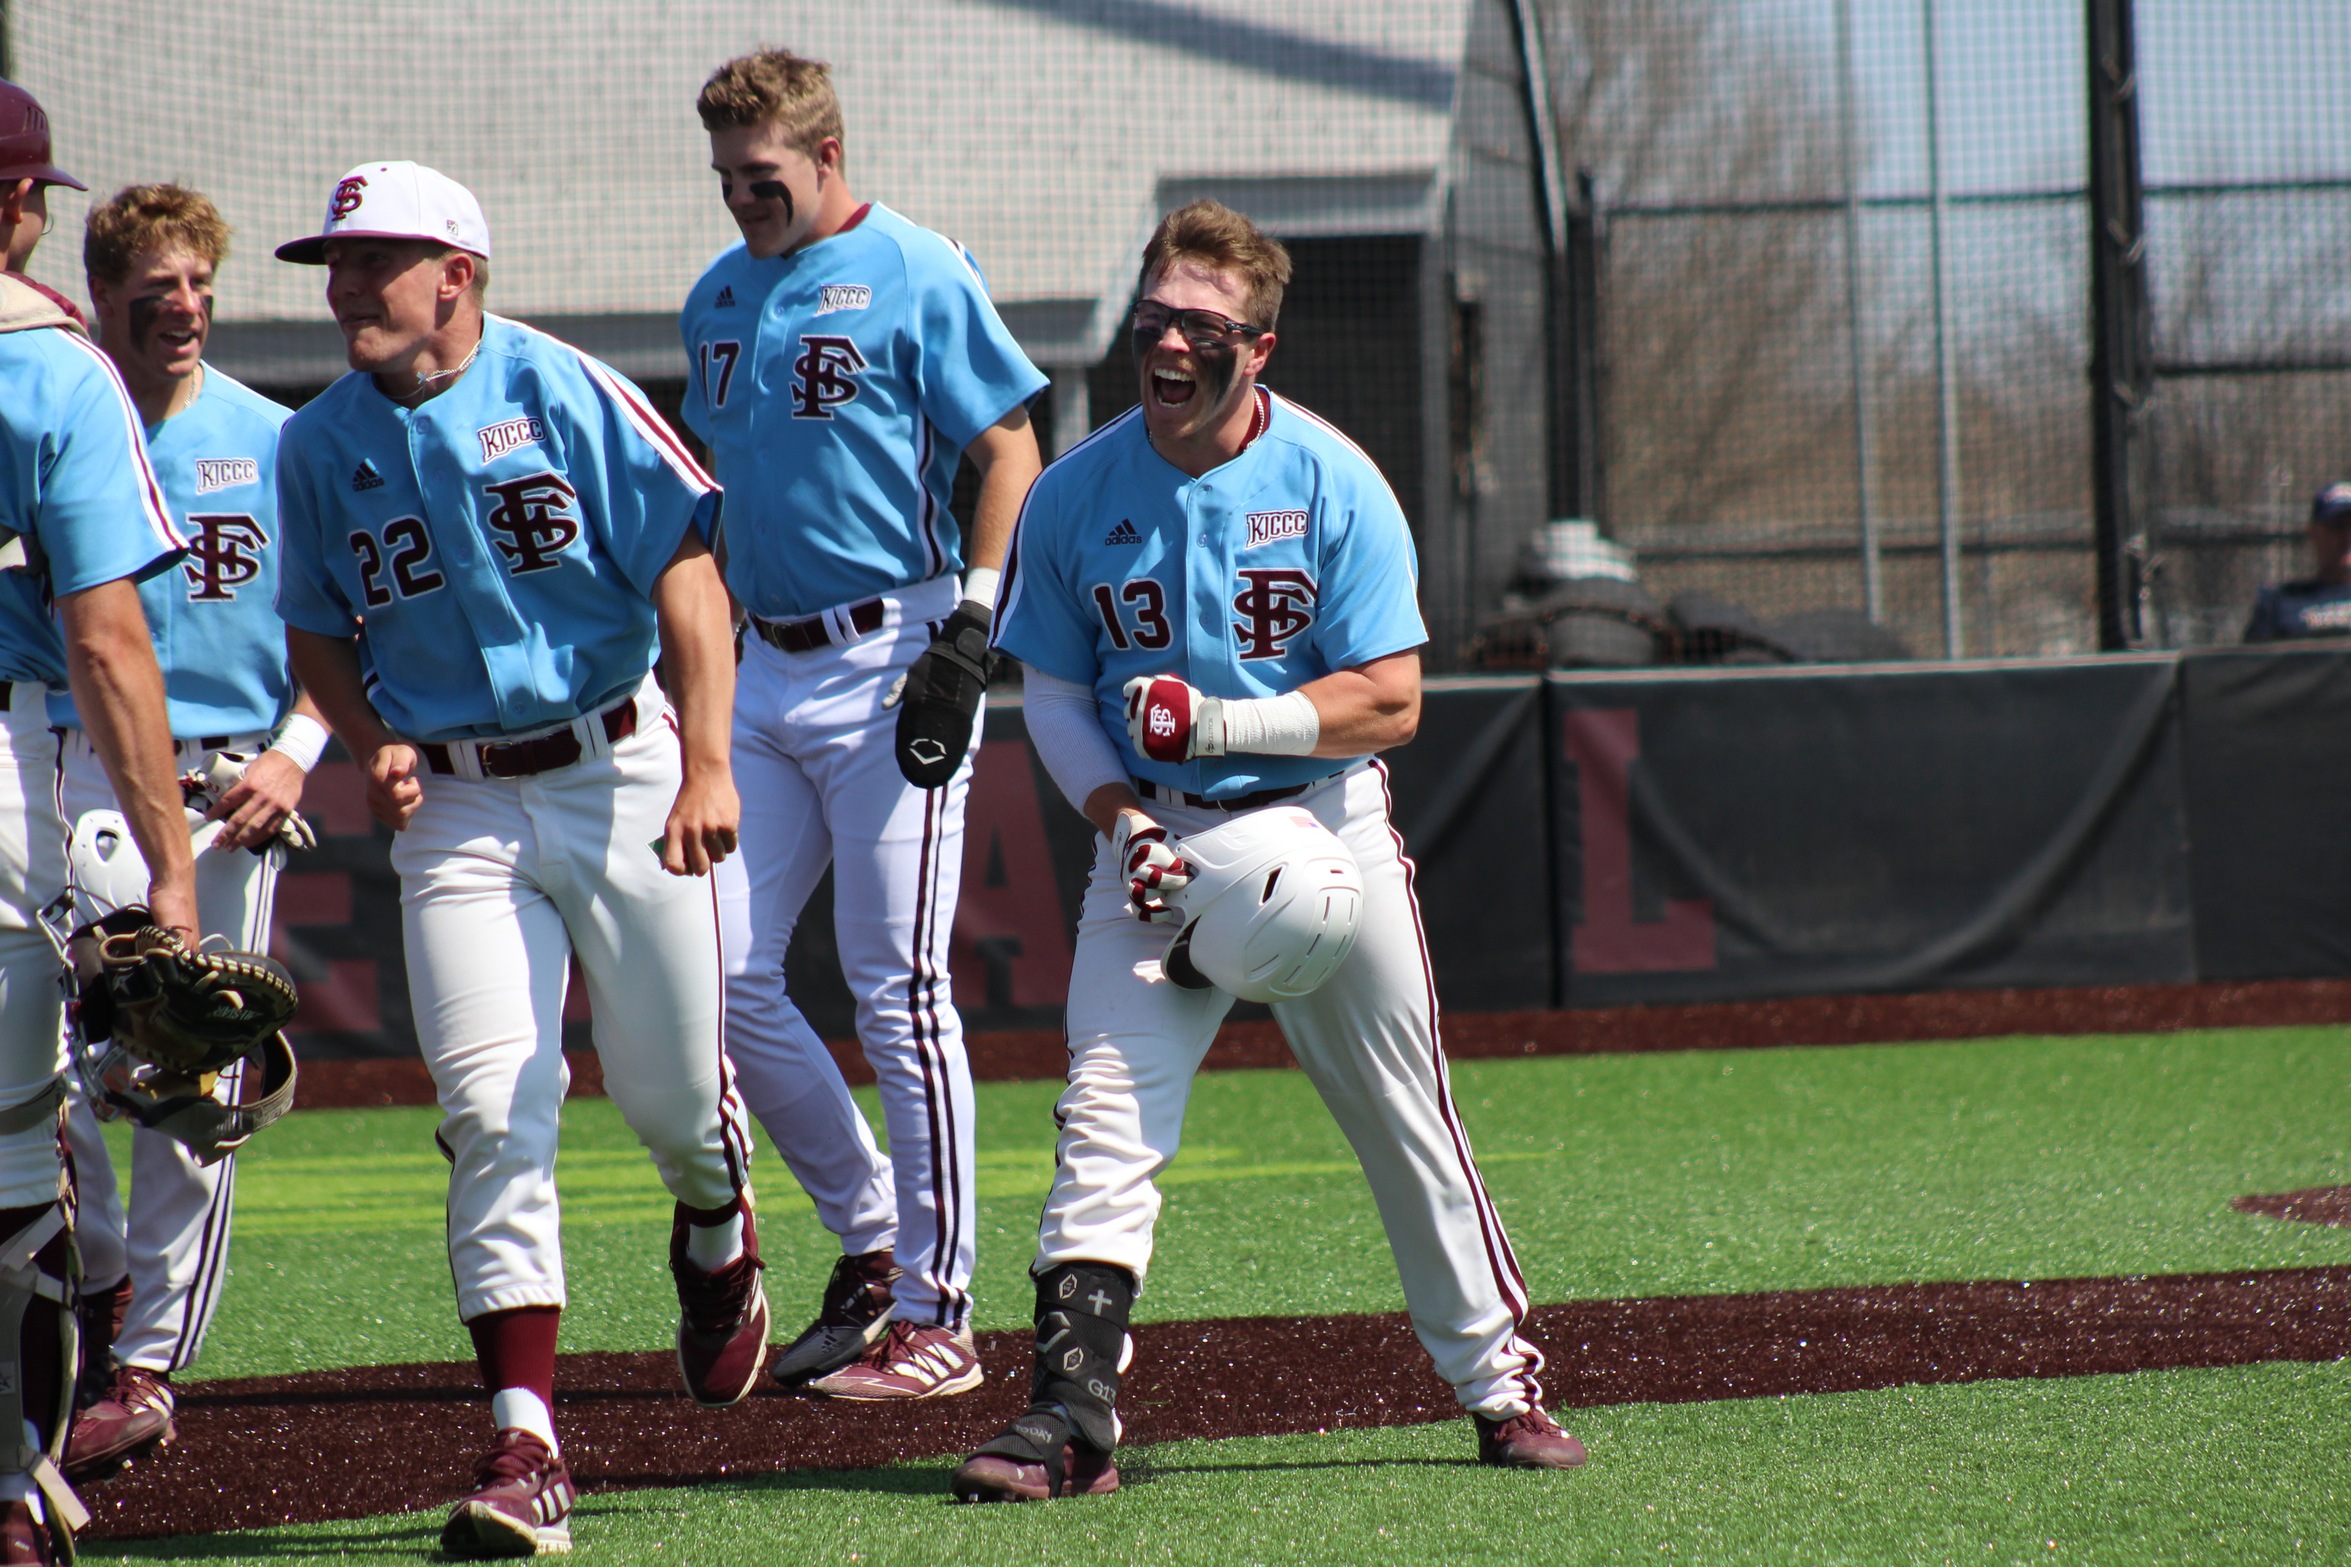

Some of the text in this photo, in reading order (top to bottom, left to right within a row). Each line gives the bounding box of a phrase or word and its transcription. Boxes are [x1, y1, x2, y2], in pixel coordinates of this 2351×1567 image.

[478, 417, 546, 465] KJCCC
[196, 459, 259, 494] KJCCC
[1104, 533, 1143, 546] adidas
[1245, 510, 1309, 550] KJCCC
[348, 514, 446, 610] 22
[1092, 577, 1174, 651] 13
